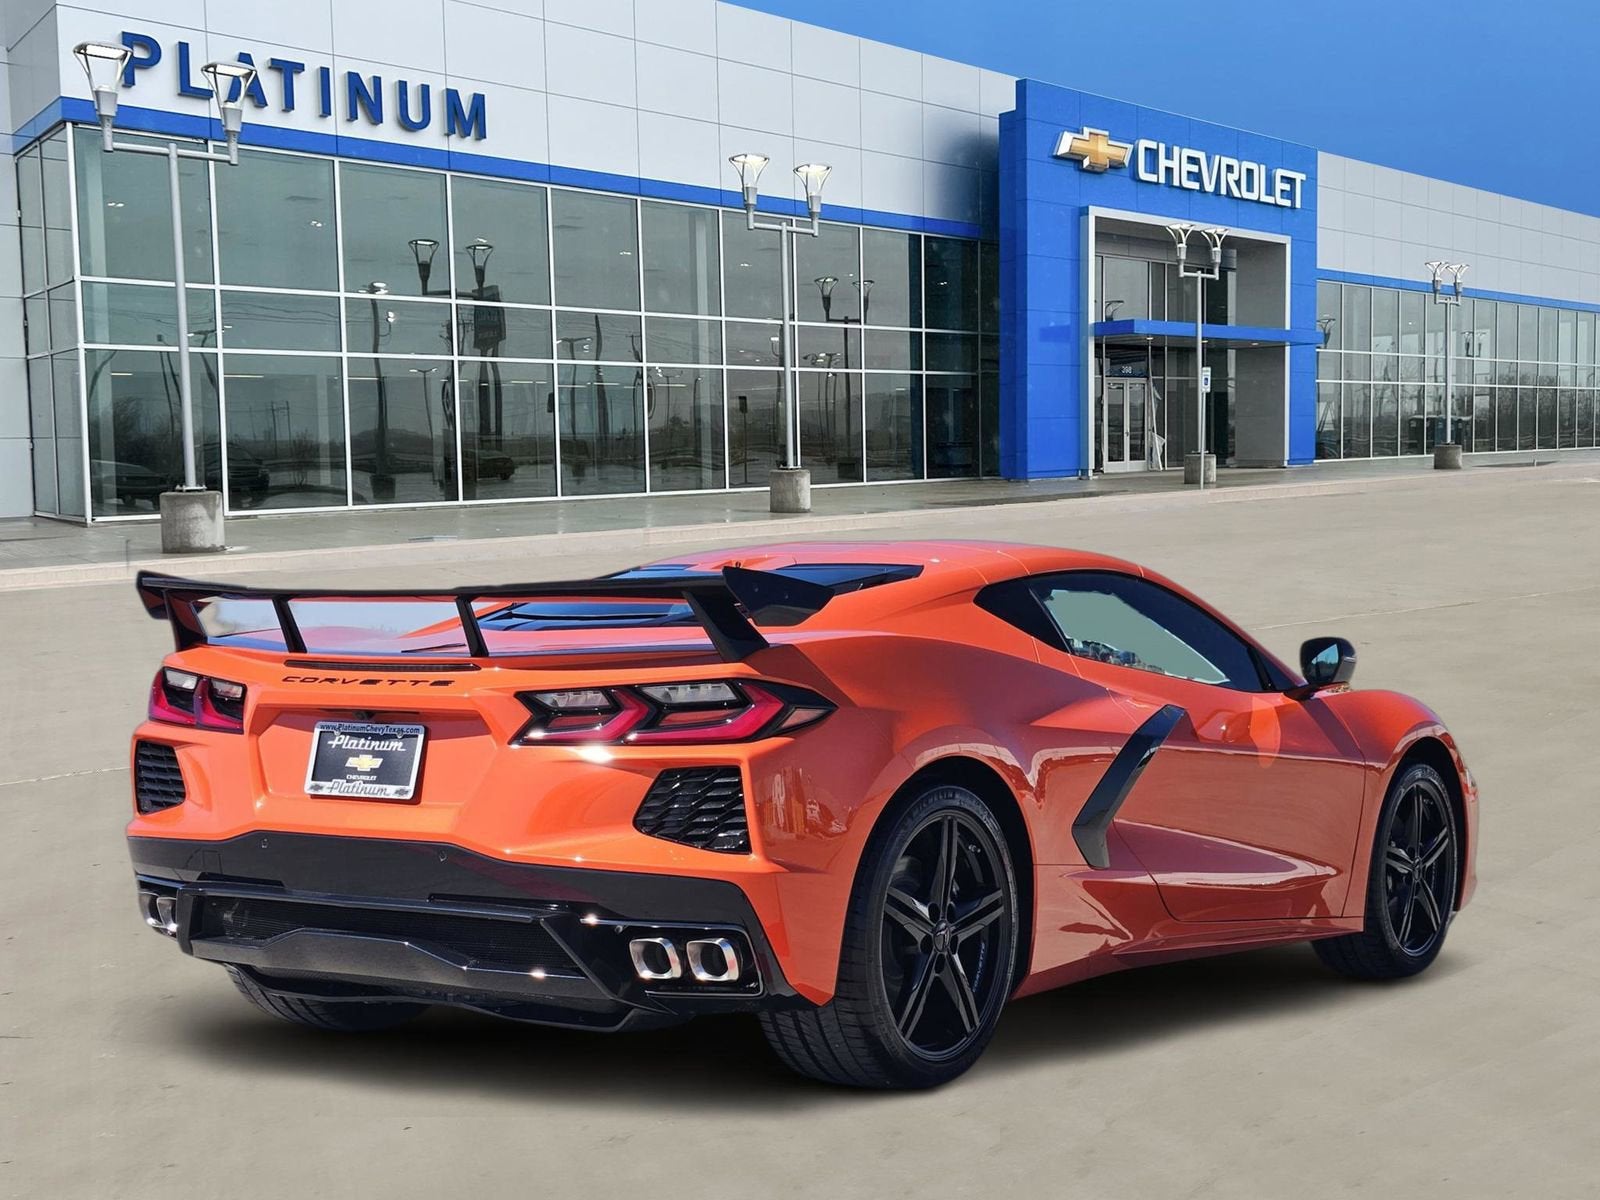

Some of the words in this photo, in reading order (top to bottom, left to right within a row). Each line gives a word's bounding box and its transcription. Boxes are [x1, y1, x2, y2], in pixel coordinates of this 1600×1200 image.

[121, 30, 488, 140] PLATINUM
[1137, 138, 1307, 209] CHEVROLET
[281, 676, 455, 686] CORVETTE
[320, 723, 420, 734] www.PlatinumChevyTexas.com
[327, 735, 406, 751] Platinum
[327, 780, 391, 796] Platinum
